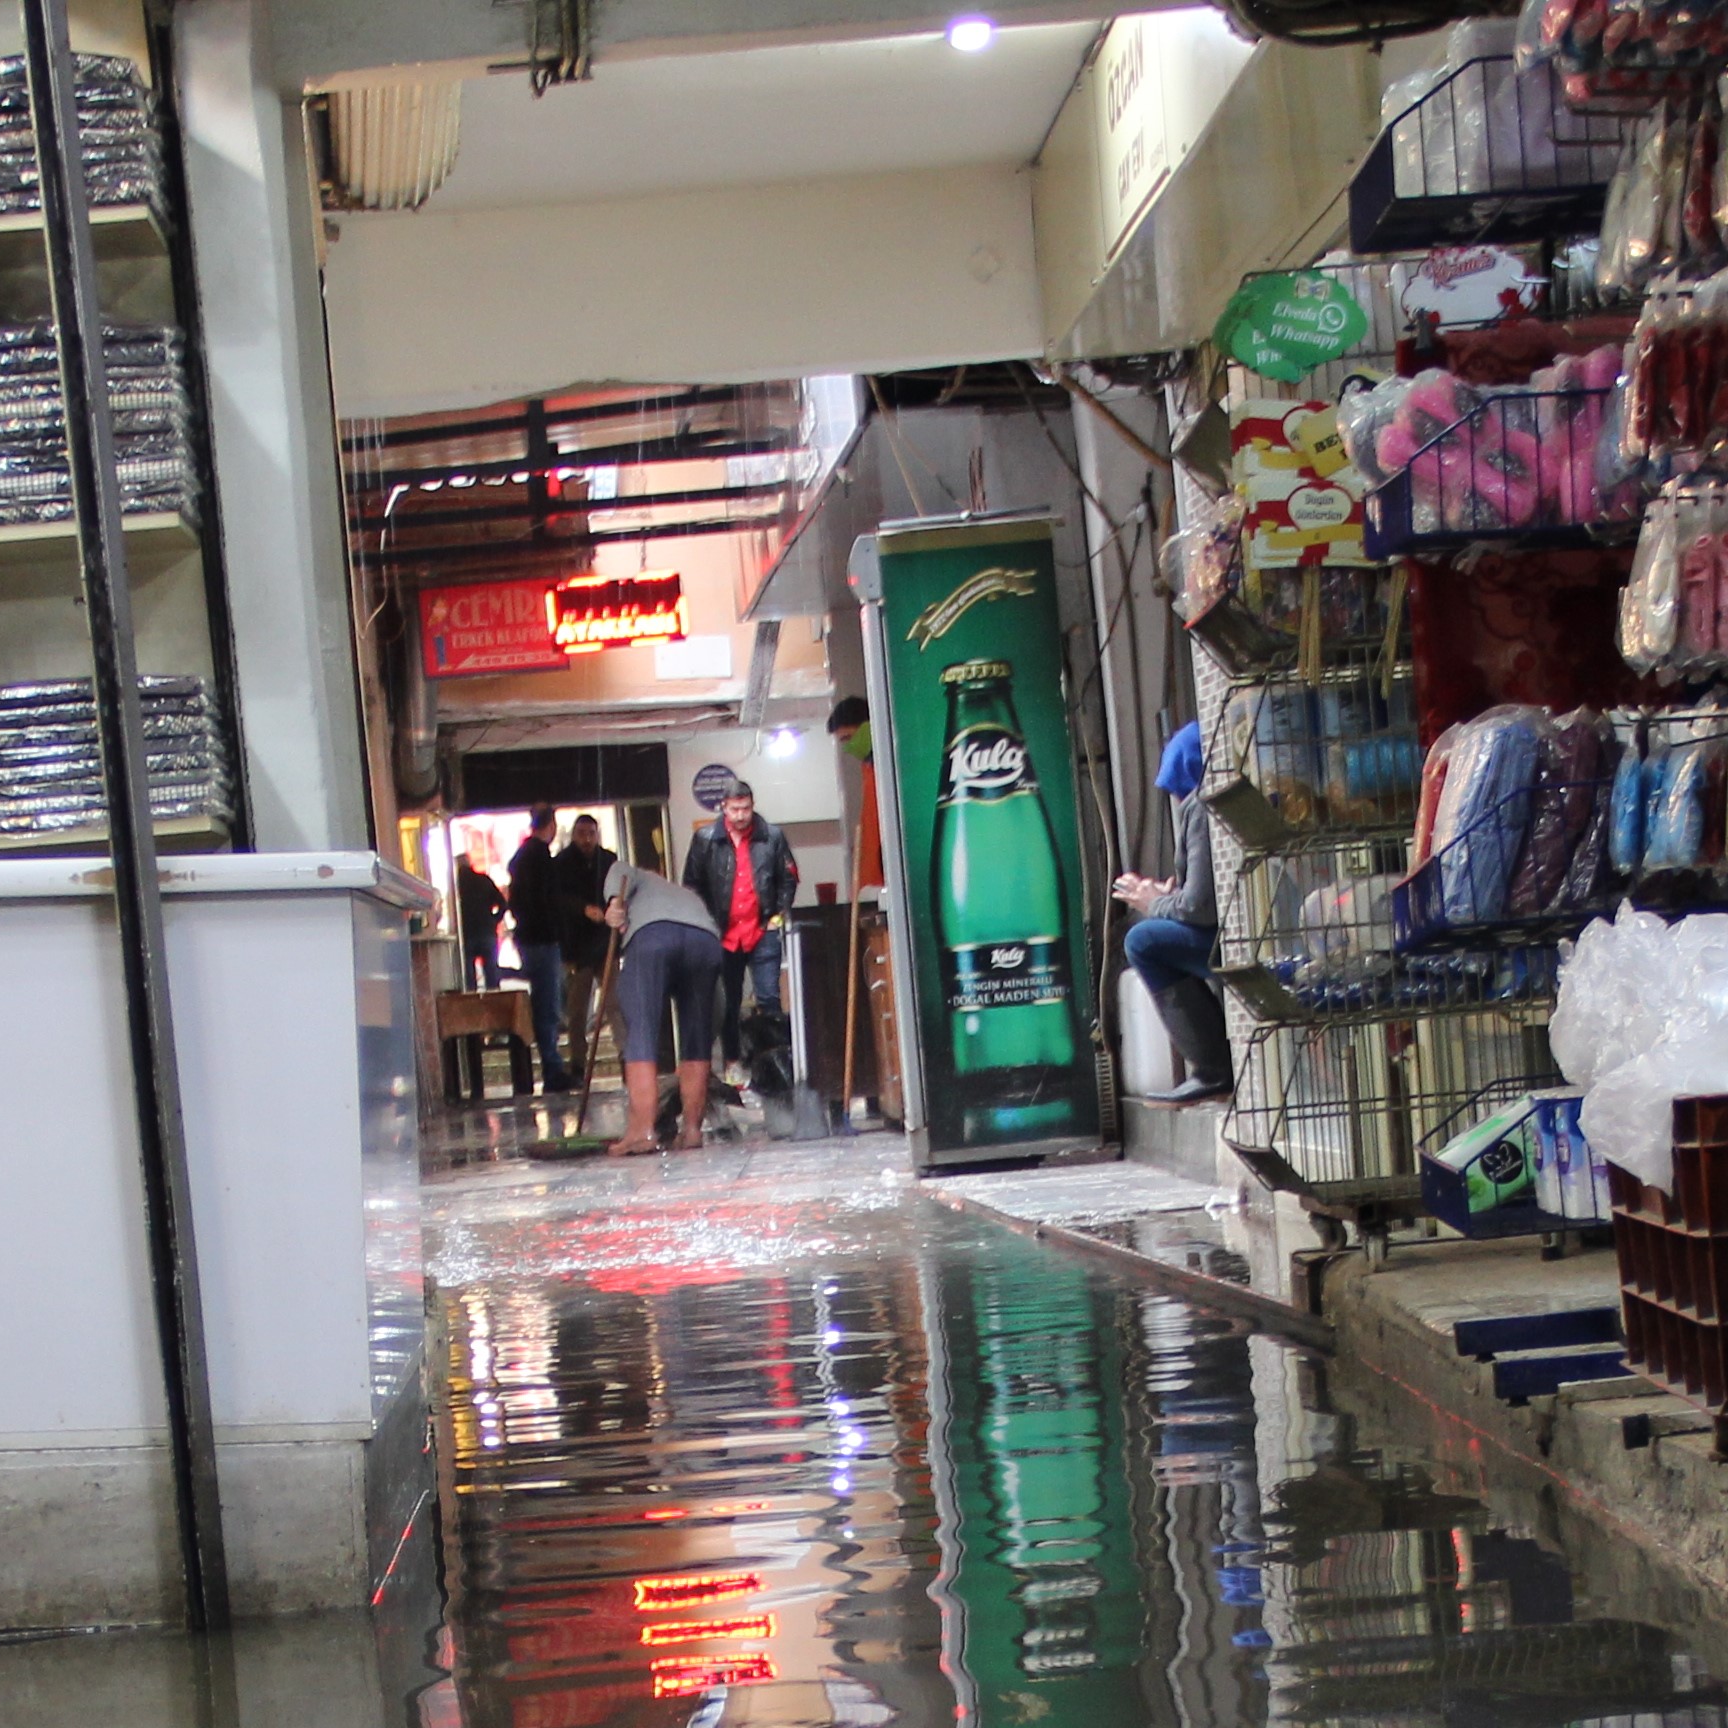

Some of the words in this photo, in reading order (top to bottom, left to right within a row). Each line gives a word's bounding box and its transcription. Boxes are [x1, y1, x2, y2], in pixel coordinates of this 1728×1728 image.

[1107, 20, 1144, 134] ÖZCAN
[1272, 302, 1318, 322] Elveda
[1270, 323, 1340, 350] Whatsapp
[949, 737, 1025, 788] Kula
[991, 947, 1025, 968] Kula
[993, 988, 1038, 1004] MADEN
